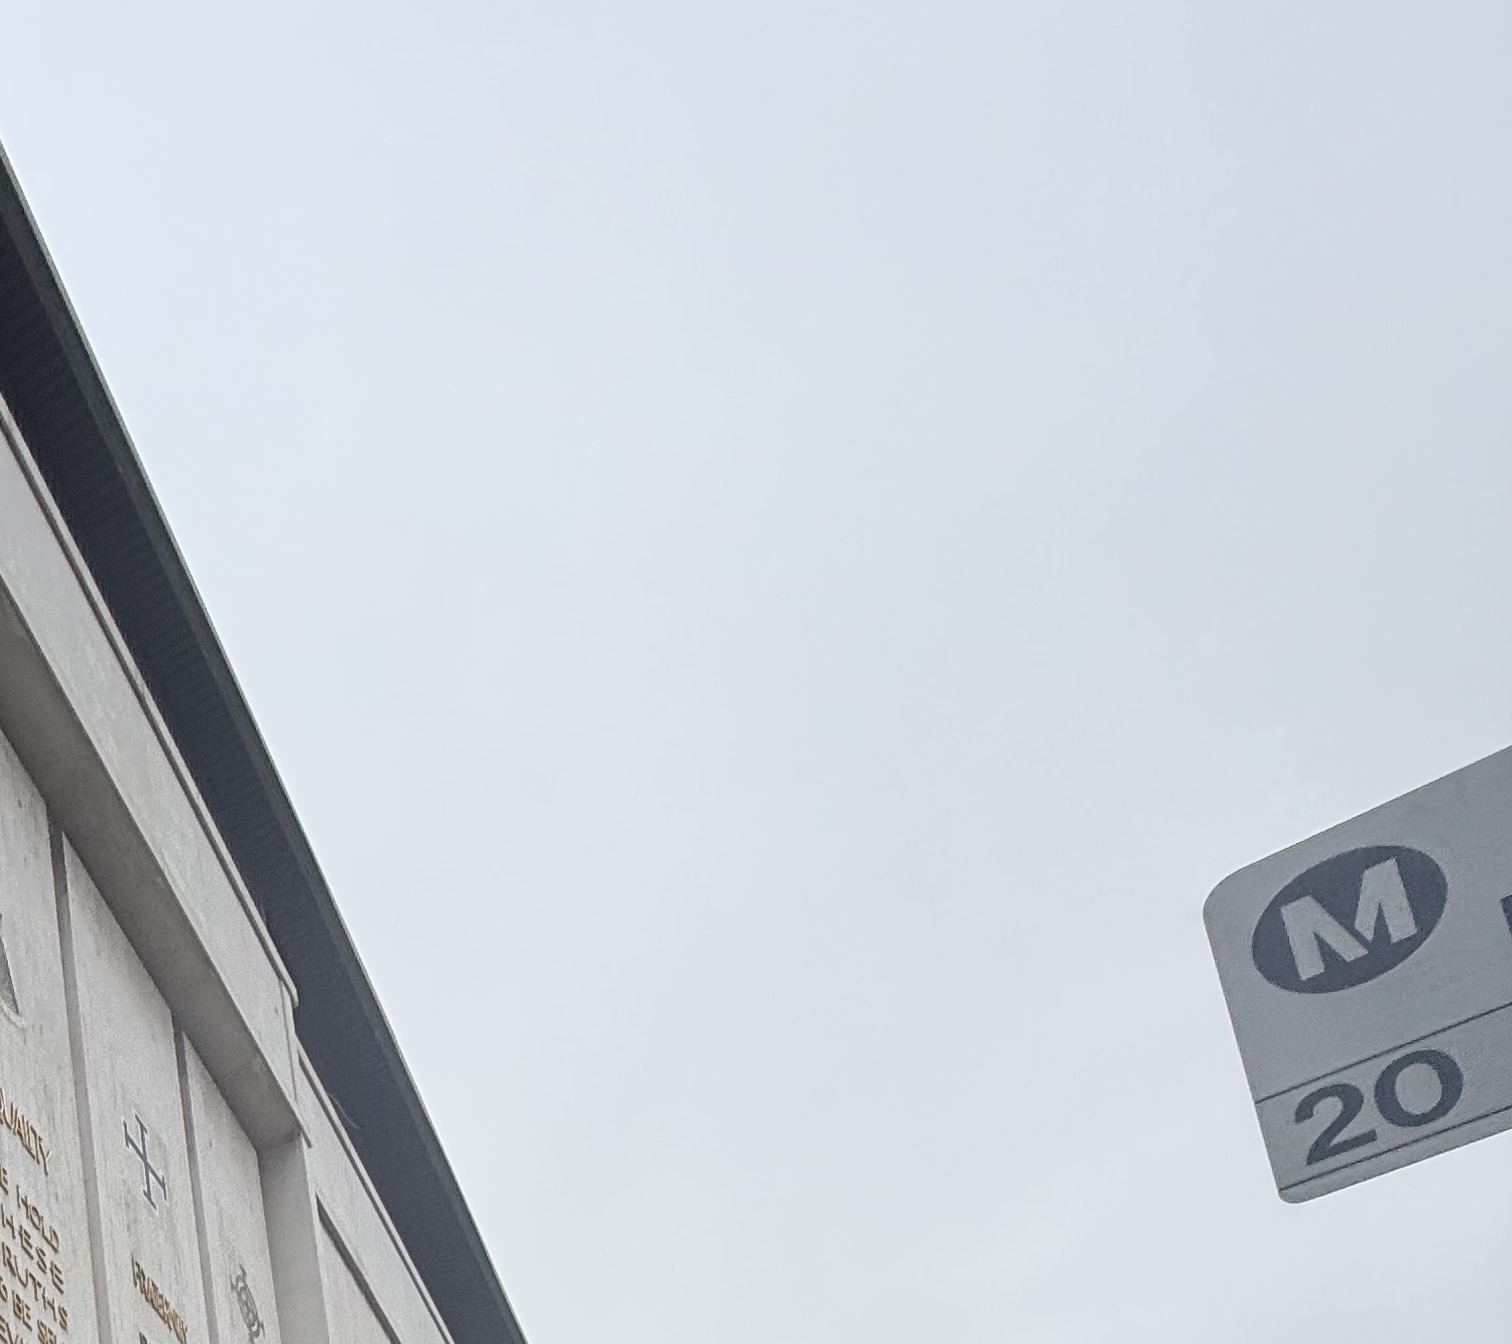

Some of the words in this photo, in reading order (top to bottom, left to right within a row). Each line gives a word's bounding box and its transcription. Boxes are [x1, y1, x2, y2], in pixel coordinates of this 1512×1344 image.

[1280, 855, 1421, 982] M
[1292, 1048, 1464, 1166] 20
[16, 1184, 60, 1252] HOLD
[11, 1289, 33, 1332] BE
